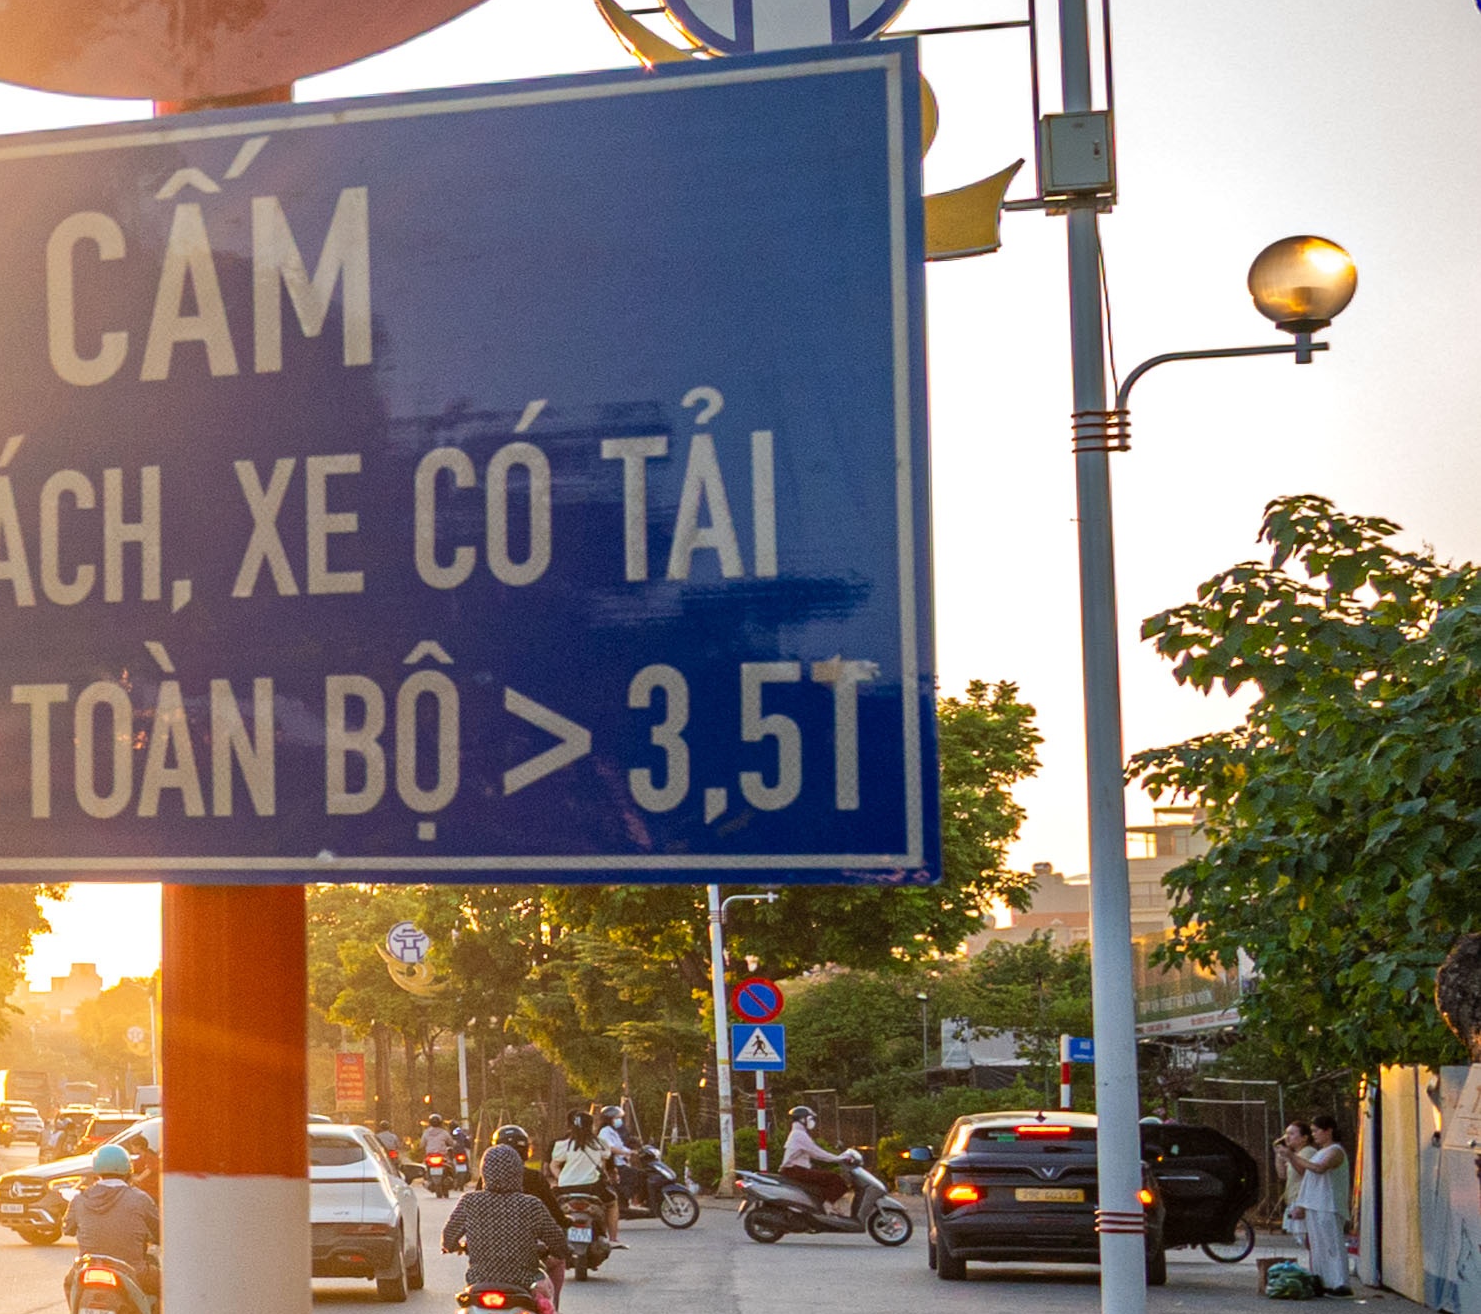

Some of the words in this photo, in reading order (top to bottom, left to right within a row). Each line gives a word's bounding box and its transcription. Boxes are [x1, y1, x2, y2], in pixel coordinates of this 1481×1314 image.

[46, 136, 372, 386] CẤM
[231, 453, 364, 598] XE
[414, 399, 551, 589] CÓ
[601, 386, 778, 583] TẢI
[11, 641, 276, 820] TOÀN
[324, 640, 460, 841] BỘ
[503, 687, 592, 795] >
[628, 655, 881, 825] 3,5T
